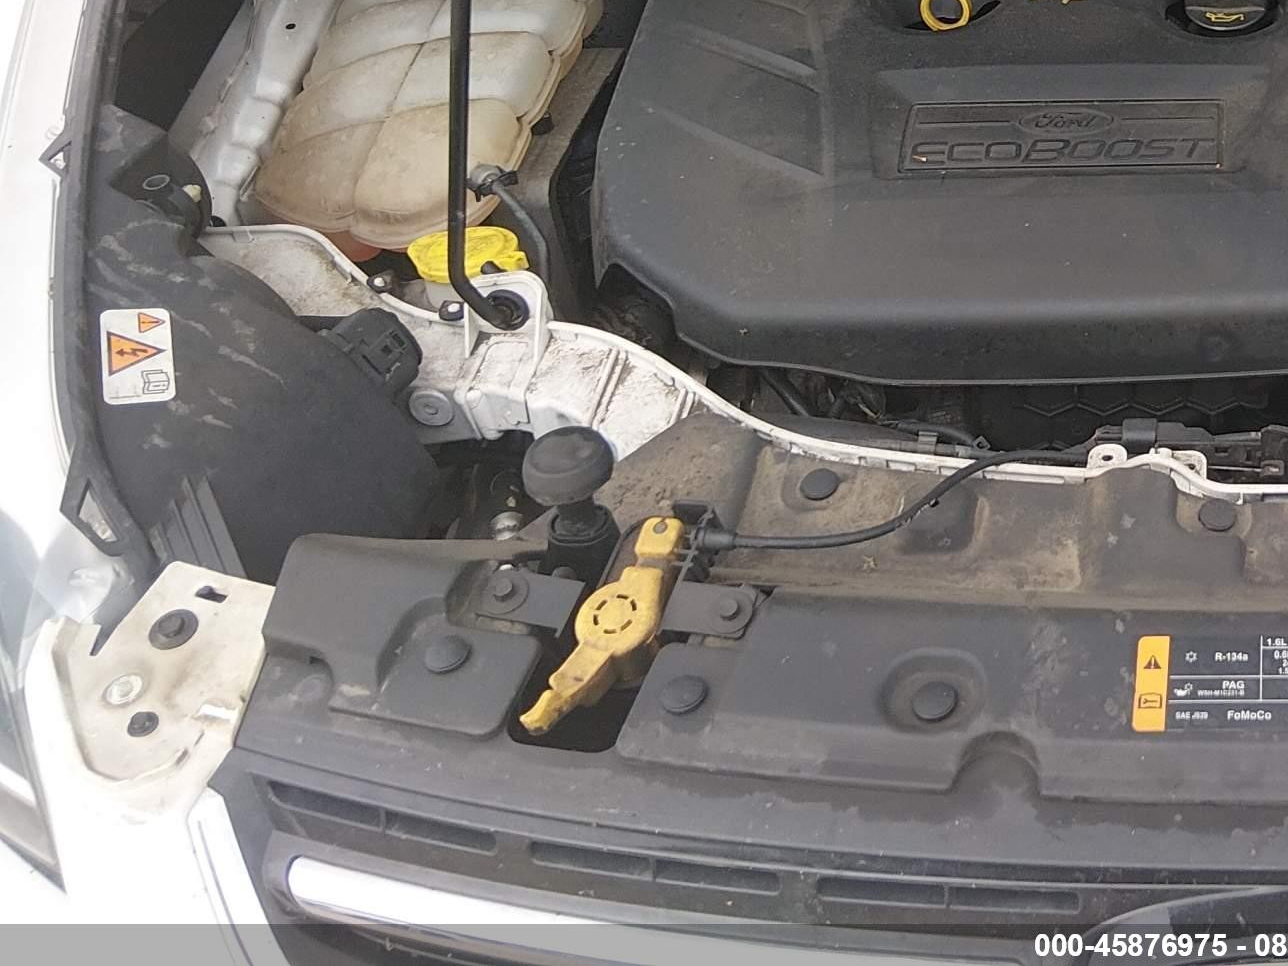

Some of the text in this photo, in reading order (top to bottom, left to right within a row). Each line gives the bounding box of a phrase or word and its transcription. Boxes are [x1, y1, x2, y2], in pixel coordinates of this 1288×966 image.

[1035, 111, 1096, 129] Ford
[1266, 637, 1287, 646] 1.6L
[1214, 651, 1249, 662] R-134a
[1222, 680, 1245, 689] PAG
[1175, 711, 1191, 720] SAE
[1226, 709, 1272, 721] FoMoCo
